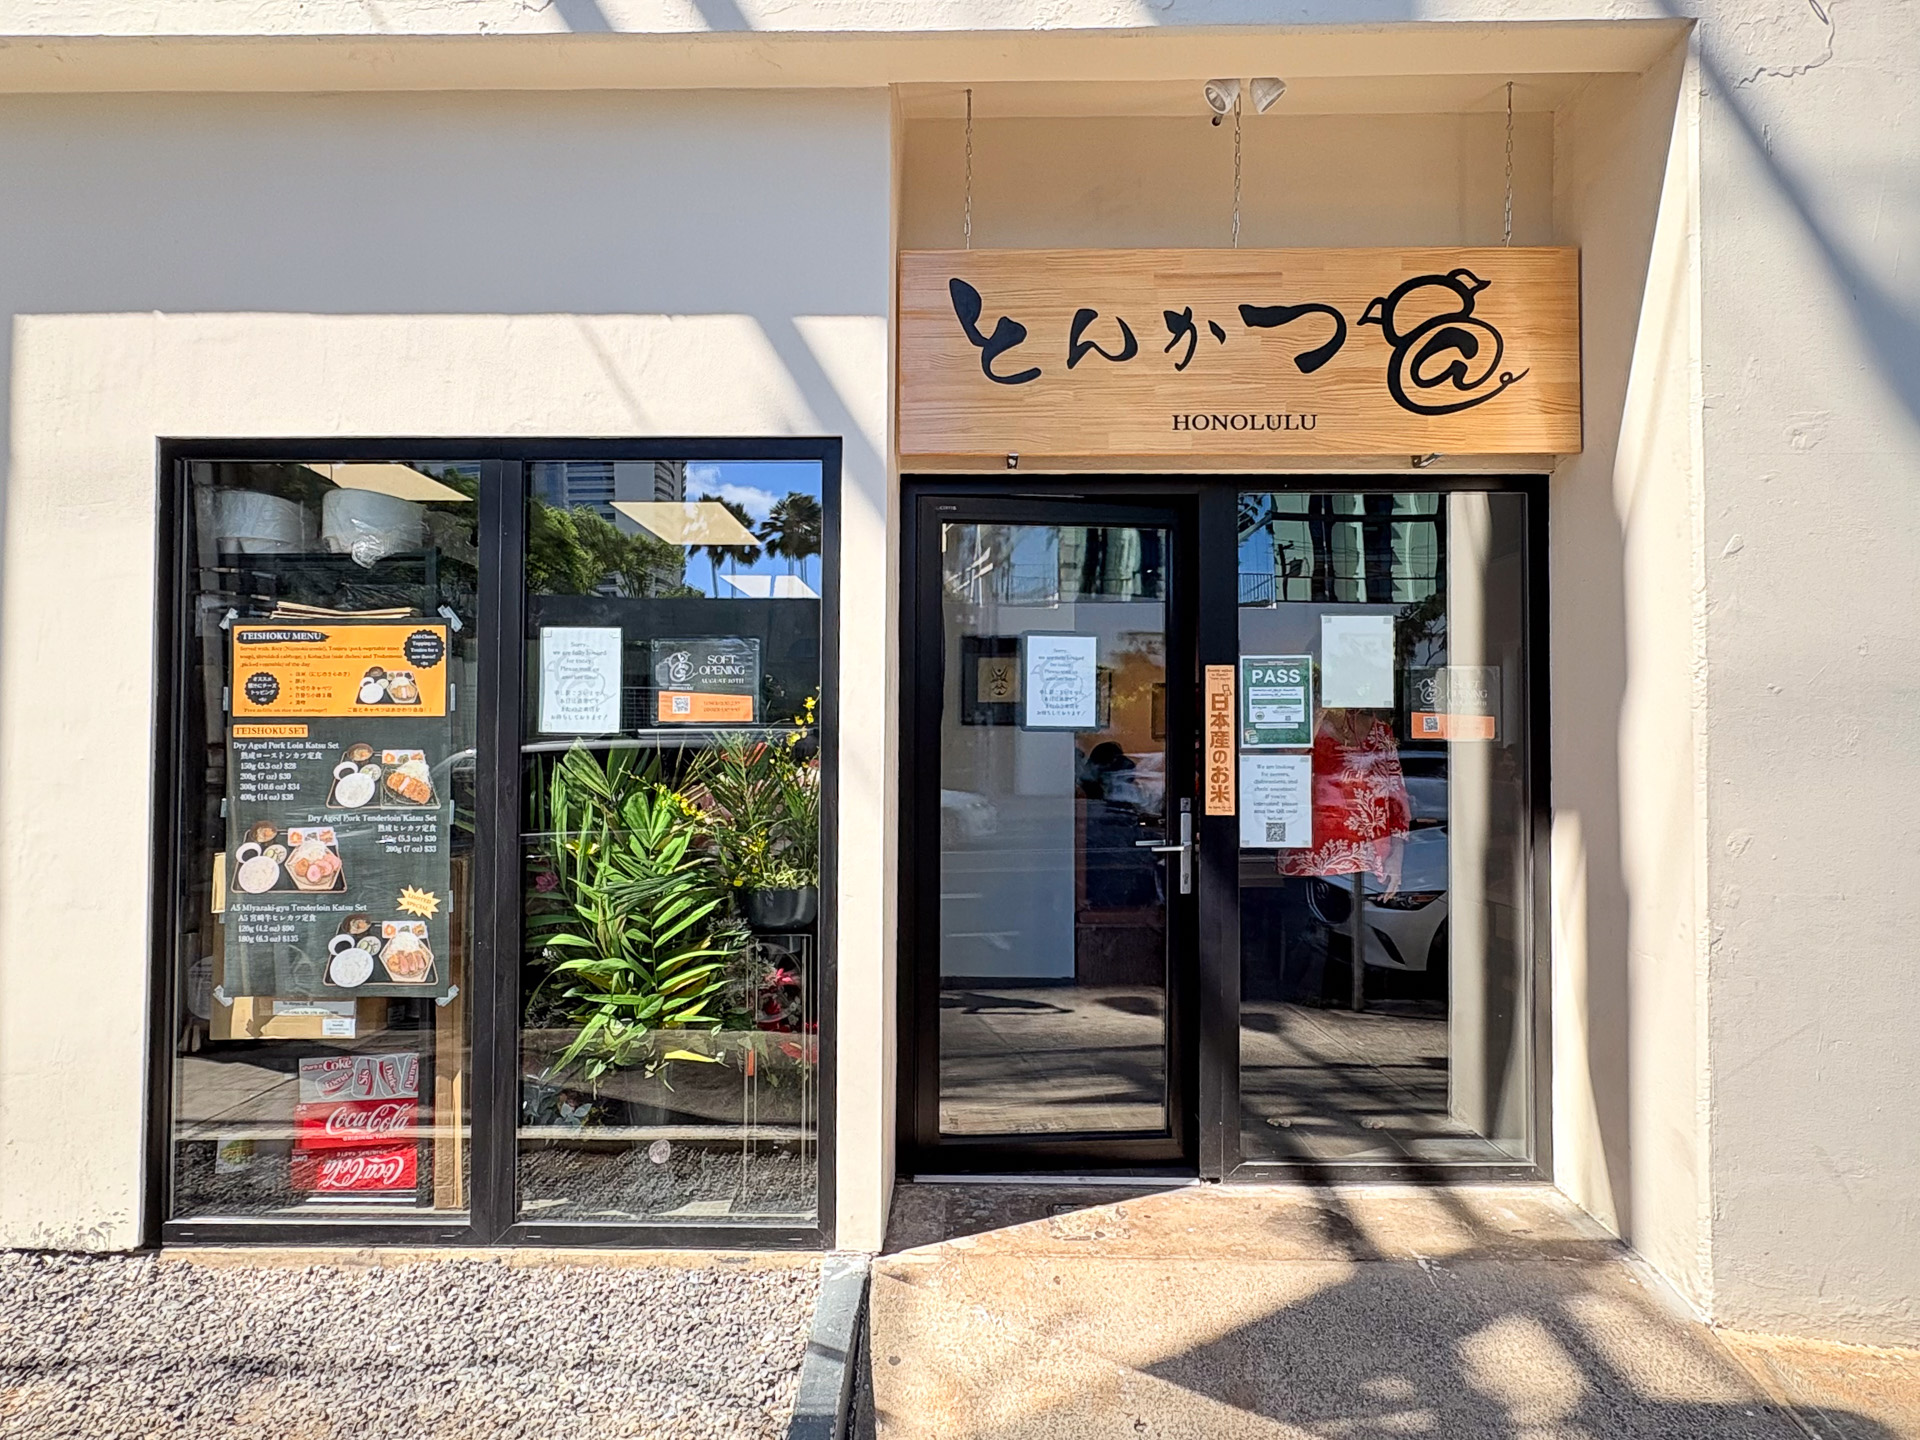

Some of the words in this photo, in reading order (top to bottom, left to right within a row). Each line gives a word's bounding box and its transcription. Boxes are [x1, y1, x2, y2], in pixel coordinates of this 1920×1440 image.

[948, 278, 1348, 385] とんかつ
[1171, 414, 1318, 432] HONOLULU
[241, 632, 290, 640] TEISHOKU
[292, 632, 321, 640] MENU
[707, 654, 736, 664] SOFT
[699, 666, 746, 676] OPENING
[1252, 669, 1300, 684] PASS
[233, 742, 247, 750] Dry
[248, 742, 268, 750] Aged
[268, 742, 286, 750] Pork
[287, 742, 304, 750] Loin
[305, 742, 326, 750] Katsu
[328, 742, 340, 750] Set
[1210, 694, 1230, 803] 日本産のお米
[308, 814, 322, 822] Dry
[322, 814, 341, 822] Aged
[362, 814, 401, 822] Tenderloin
[424, 814, 437, 822] Set
[378, 824, 436, 832] 熟成ヒレカツ定食
[230, 904, 240, 912] A5
[291, 904, 330, 912] Tenderloin
[332, 904, 354, 912] Katsu
[354, 904, 368, 912] Set
[238, 914, 248, 922] A5
[250, 914, 316, 922] 宮崎牛ヒレカツ定食
[323, 1056, 352, 1072] Coke
[358, 1070, 369, 1085] Sis
[326, 1103, 414, 1135] Coca-Cola
[318, 1156, 404, 1186] Coca-Cola
